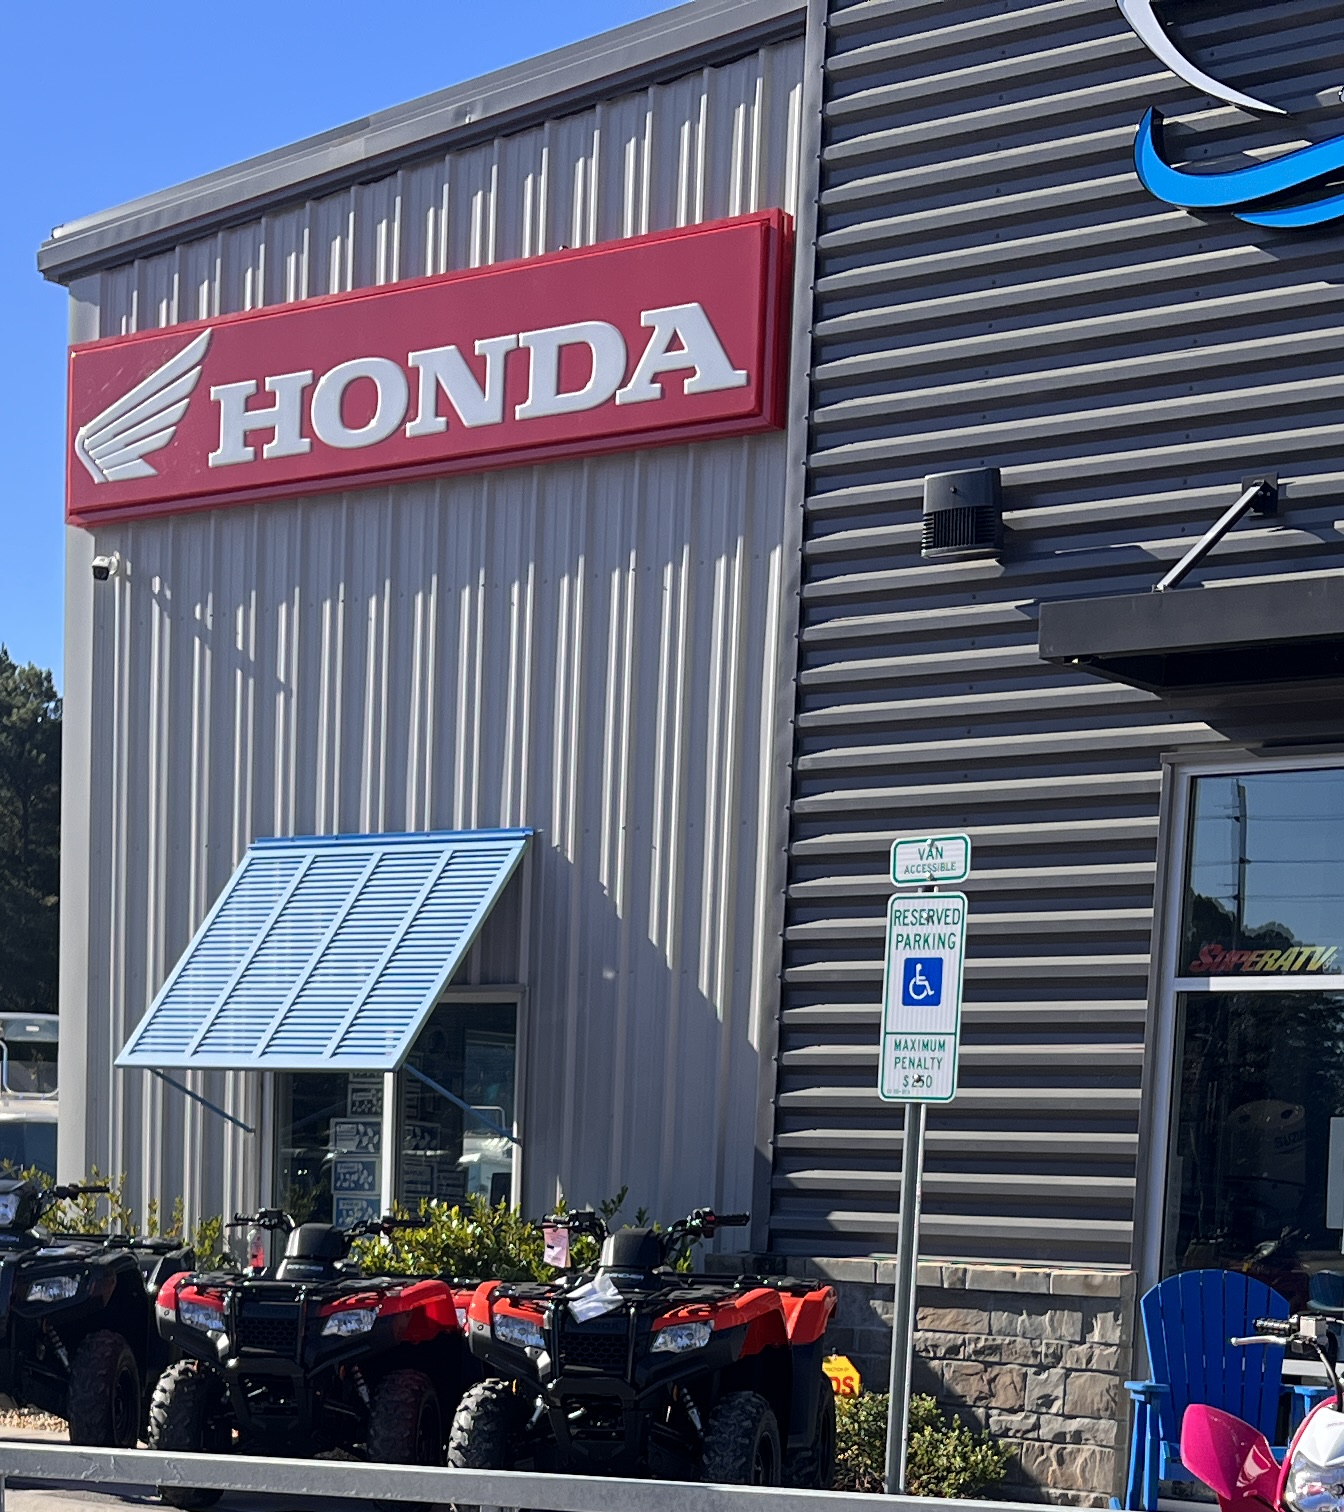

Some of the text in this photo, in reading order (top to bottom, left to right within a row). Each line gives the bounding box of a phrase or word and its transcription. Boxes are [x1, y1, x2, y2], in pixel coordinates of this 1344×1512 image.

[208, 302, 748, 467] HONDA
[918, 846, 944, 861] VAN
[904, 861, 957, 875] ACCESSIBLE
[893, 908, 961, 926] RESERVED
[895, 932, 957, 951] PARKING
[894, 1038, 946, 1052] MAXIMUM
[894, 1056, 943, 1070] PENALTY
[830, 1376, 854, 1397] DS
